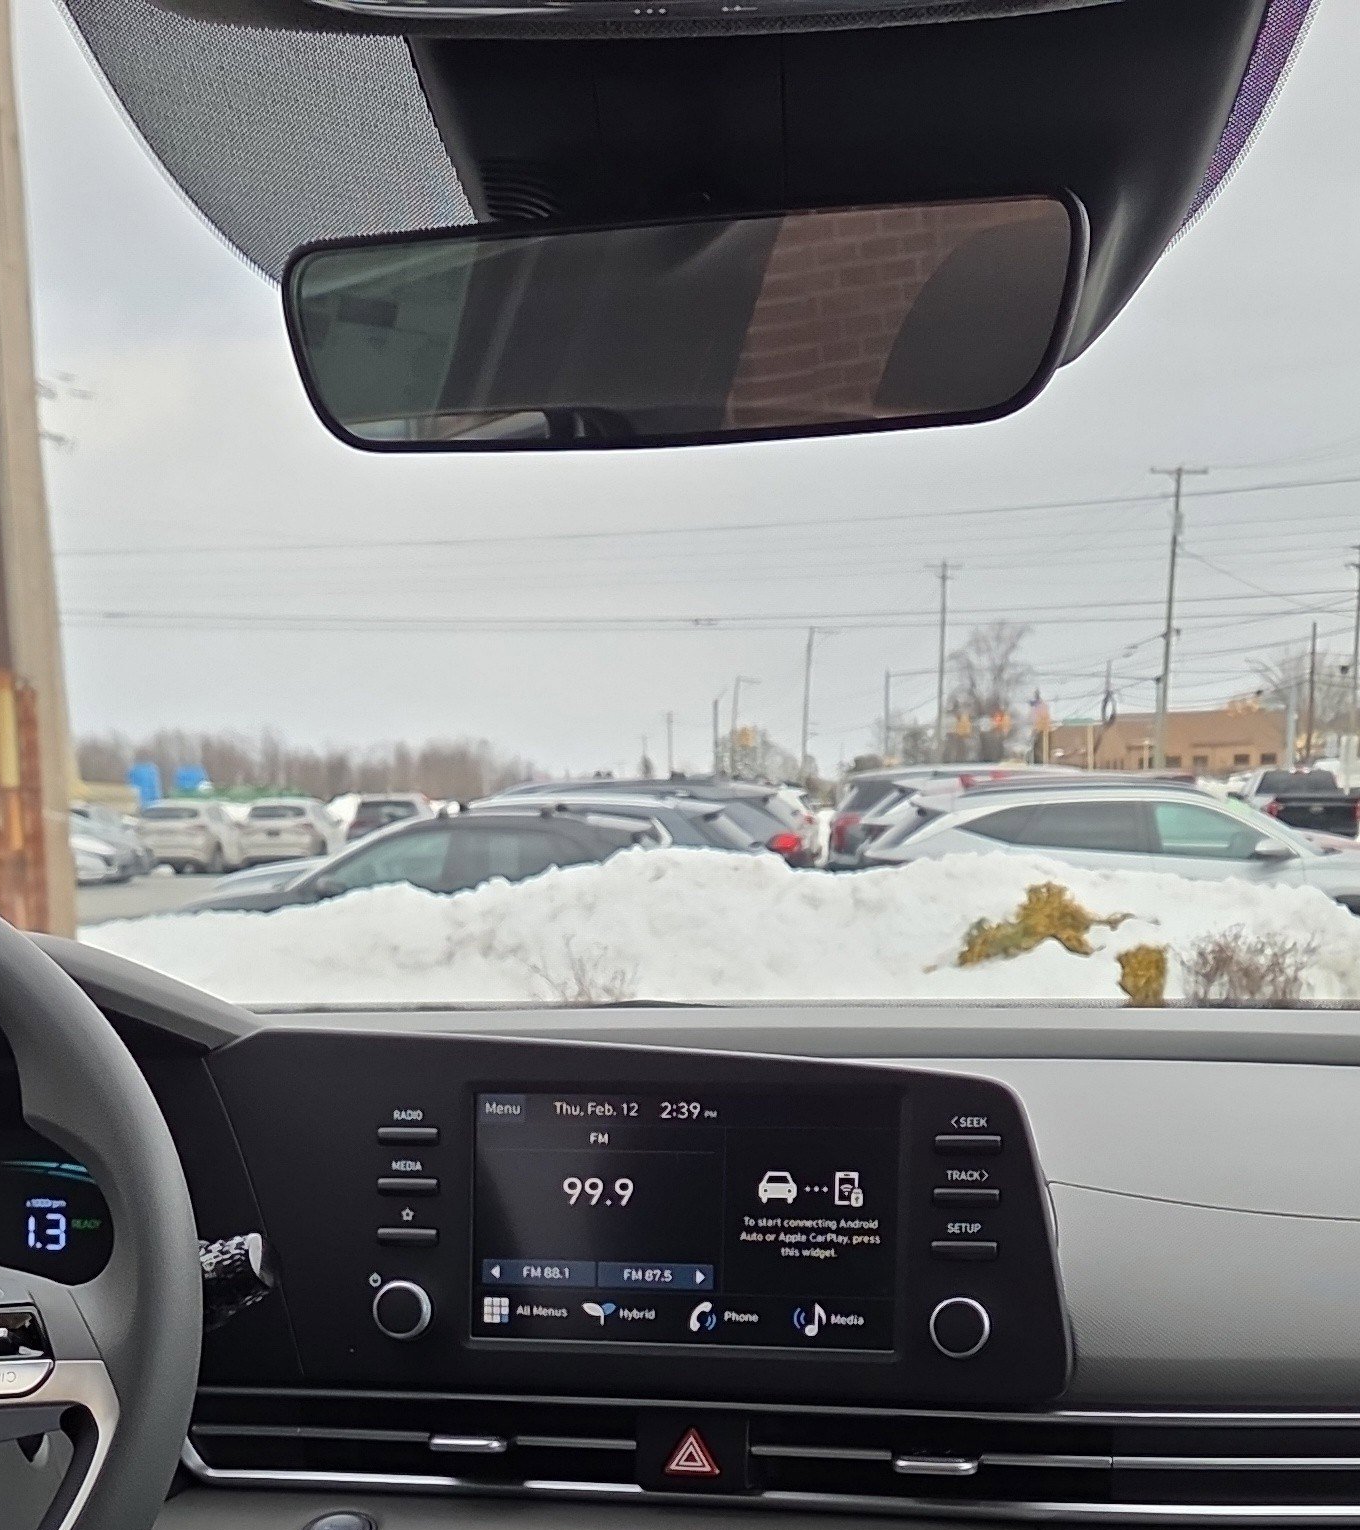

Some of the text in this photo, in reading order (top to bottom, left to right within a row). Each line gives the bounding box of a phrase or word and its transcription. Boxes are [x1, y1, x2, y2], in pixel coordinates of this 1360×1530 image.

[393, 1109, 423, 1120] RADIO
[485, 1102, 521, 1115] Menu
[552, 1101, 584, 1116] Thu,
[587, 1102, 617, 1116] Feb.
[621, 1102, 639, 1116] 12
[660, 1101, 700, 1119] 2:39
[589, 1132, 609, 1145] FM
[391, 1160, 422, 1171] MEDIA
[562, 1176, 635, 1207] 99.9
[743, 1216, 879, 1230] To start connecting Android
[947, 1222, 982, 1234] SETUP
[28, 1212, 67, 1250] 1.3
[740, 1231, 764, 1241] Auto
[765, 1233, 777, 1241] or
[778, 1232, 807, 1243] Apple
[852, 1234, 880, 1245] press
[780, 1247, 838, 1259] this widget.
[522, 1265, 571, 1279] FM 88.1
[623, 1268, 673, 1283] FM 87.5
[516, 1304, 568, 1318] All Menus
[619, 1306, 656, 1321] Hybrid
[724, 1310, 759, 1324] Phone
[831, 1313, 865, 1327] Media
